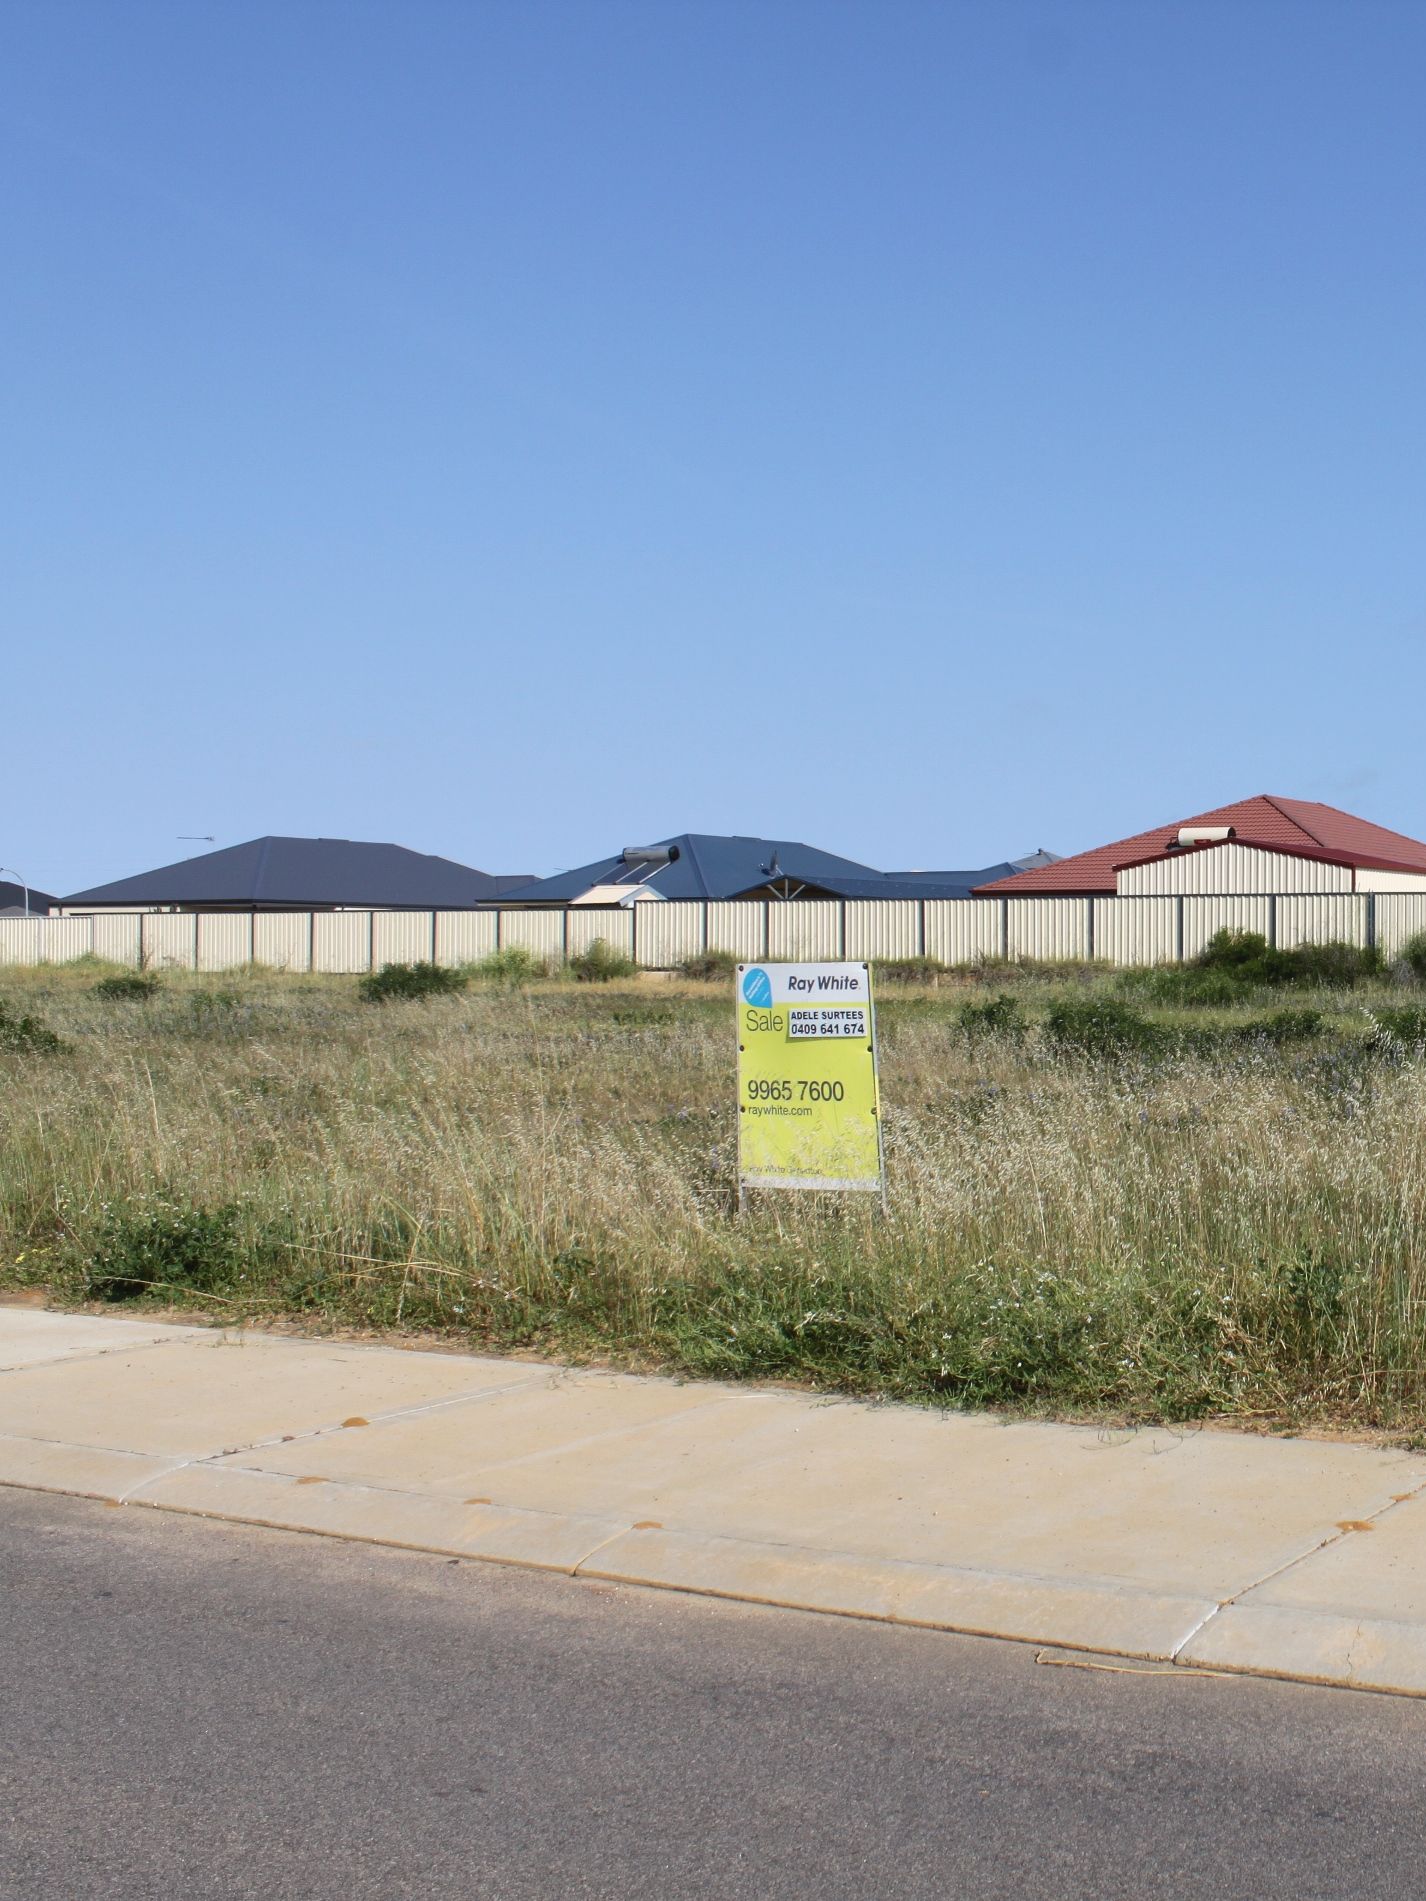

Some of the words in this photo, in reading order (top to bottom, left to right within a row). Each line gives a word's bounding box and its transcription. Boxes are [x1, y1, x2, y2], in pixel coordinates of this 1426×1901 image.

[788, 975, 814, 993] Ray
[818, 975, 859, 990] White
[746, 1009, 783, 1032] Sale
[791, 1011, 819, 1020] ADELE
[821, 1011, 864, 1020] SURTEES
[791, 1024, 817, 1035] 0409
[820, 1024, 839, 1035] 641
[843, 1024, 865, 1035] 674
[748, 1079, 793, 1101] 9965
[797, 1080, 844, 1102] 7600
[748, 1105, 812, 1117] raywhite.com
